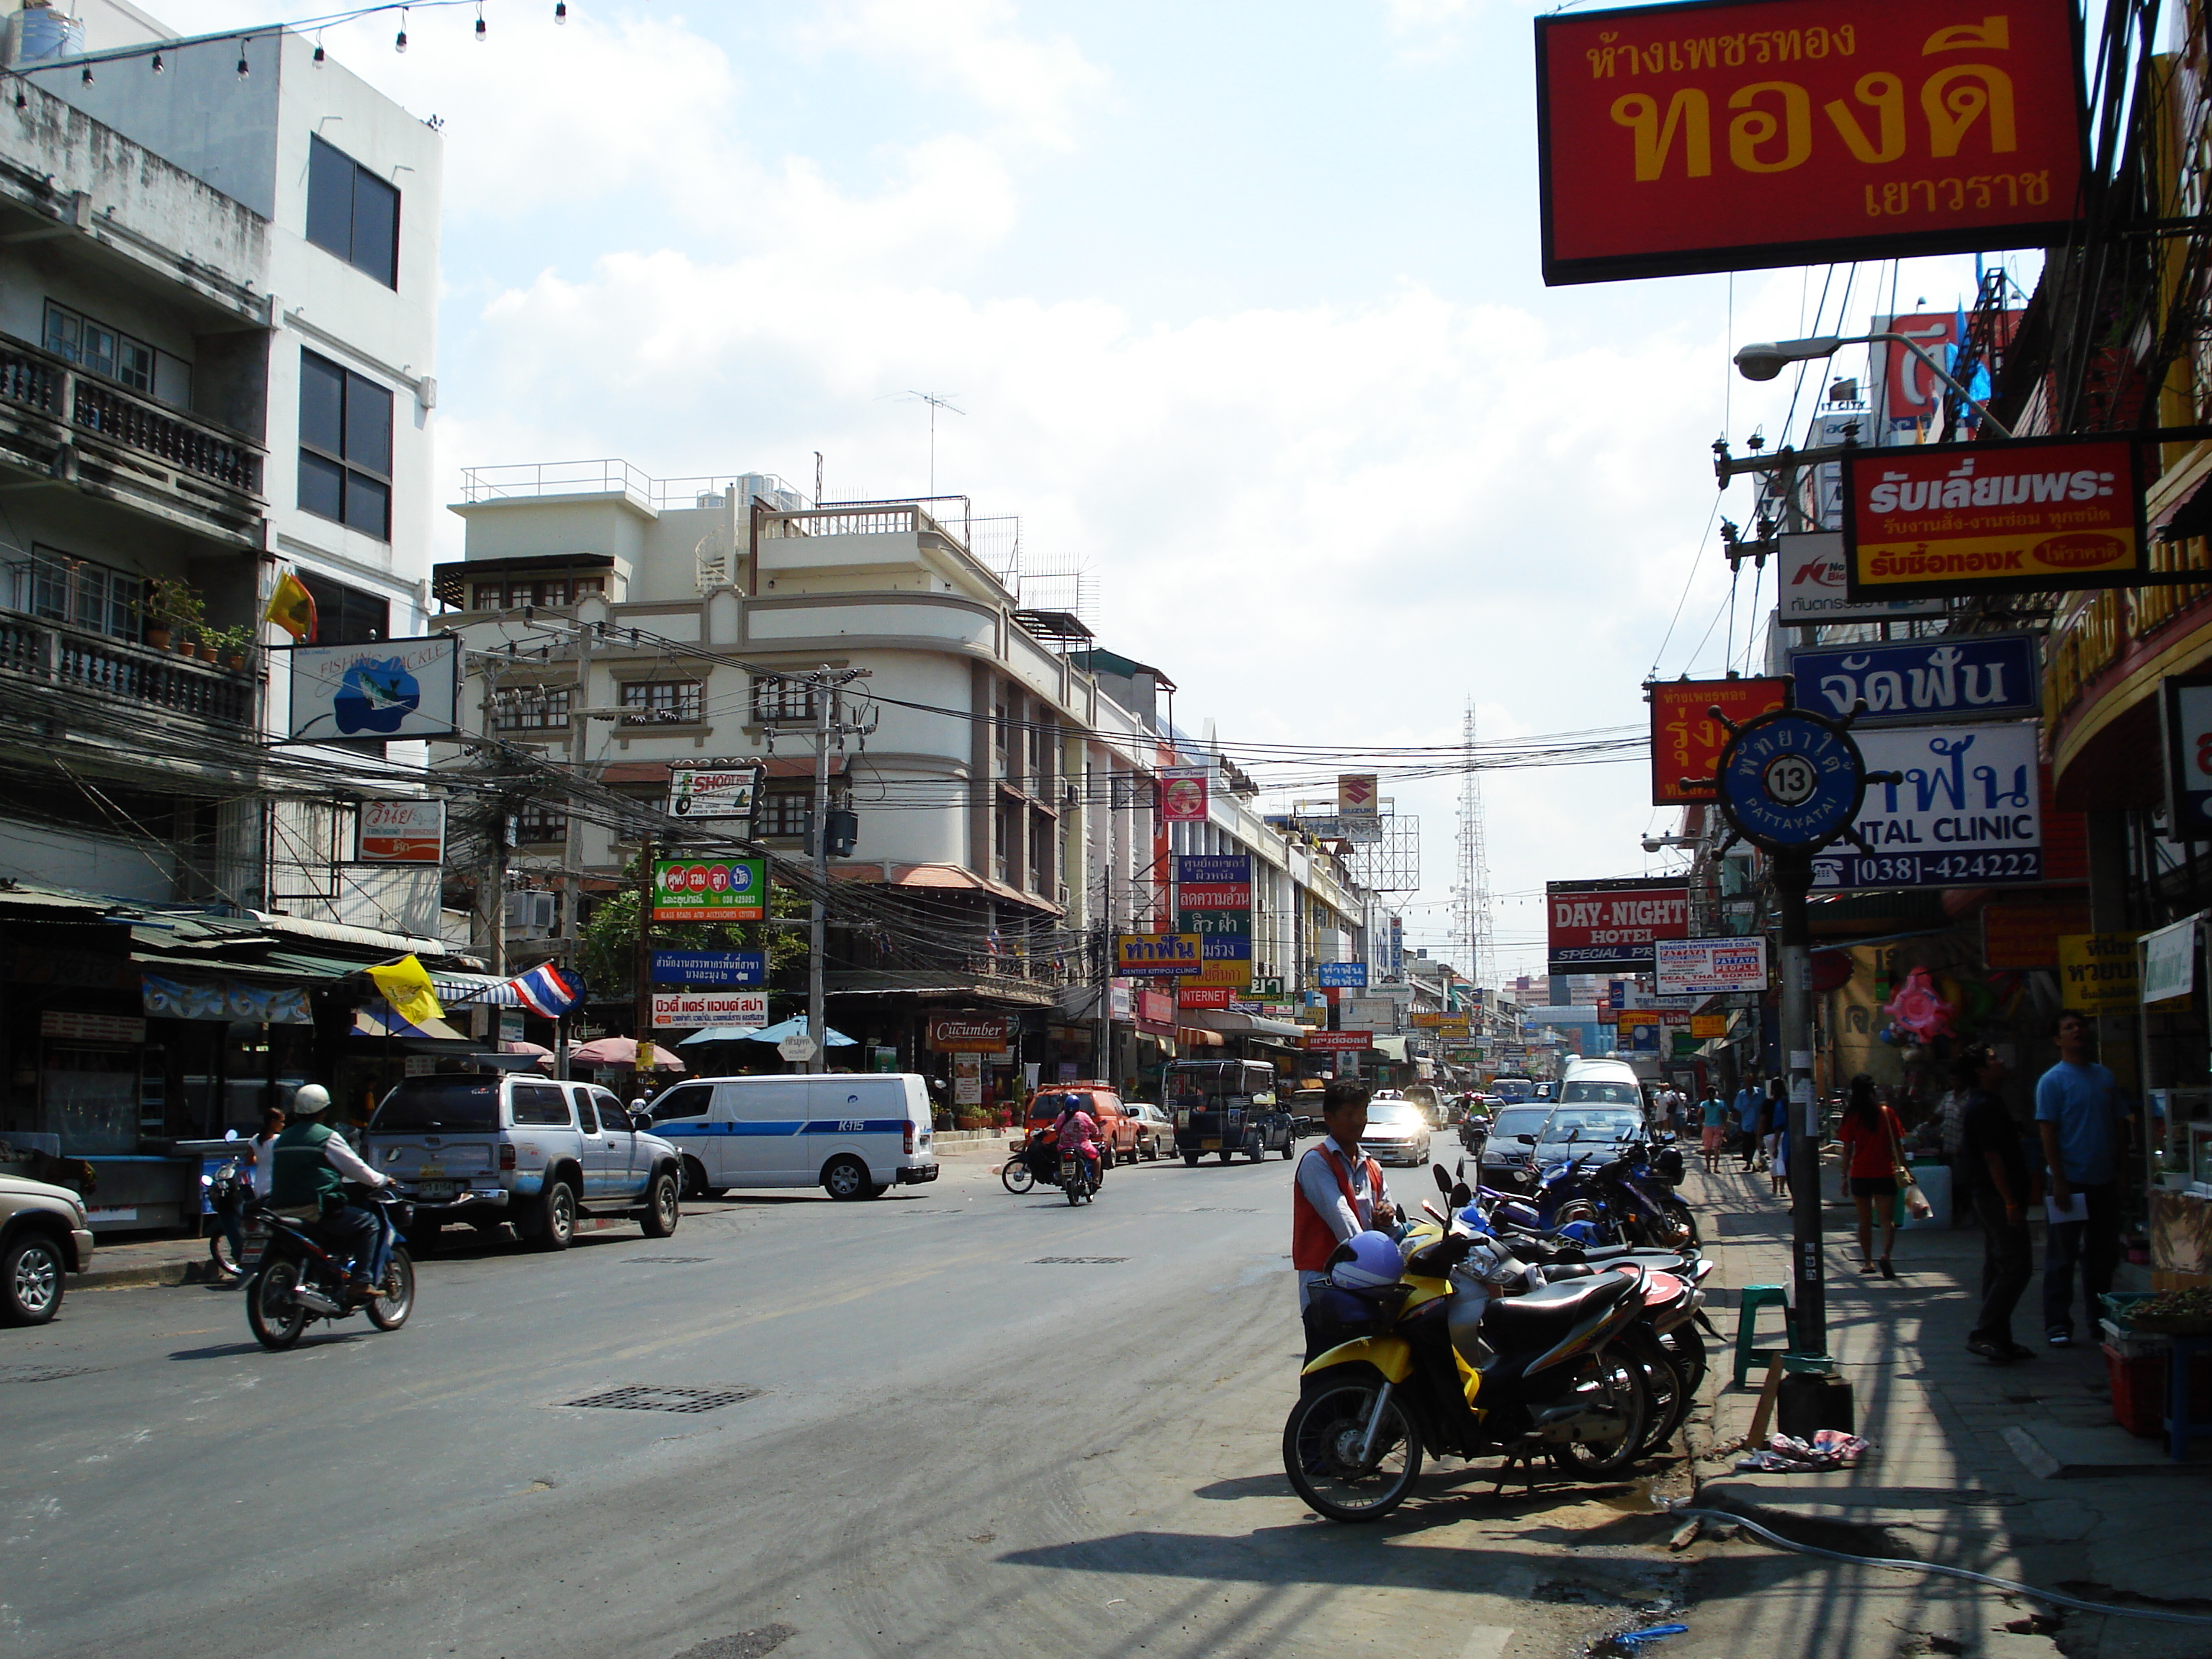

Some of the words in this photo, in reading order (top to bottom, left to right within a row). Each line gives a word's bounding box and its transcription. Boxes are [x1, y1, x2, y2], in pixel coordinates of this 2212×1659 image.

[1586, 24, 1856, 79] ห้างเพชรทอง
[1610, 15, 2017, 182] ทองดี
[1865, 168, 2051, 217] เยาวราช
[1869, 458, 2115, 513] รับเลี่ยมพระ
[2049, 505, 2111, 529] ทุกชนิด
[320, 650, 382, 677] FISHING
[390, 642, 445, 671] TACKLE
[1820, 647, 2008, 714] จัดฟัน
[1737, 729, 1855, 776] พัทยาใต้
[1774, 767, 1806, 793] 13
[1934, 814, 2033, 842] CLINIC
[1196, 869, 1234, 881] ผิวหนัง
[1179, 886, 1250, 907] ลดความอ้วน
[1125, 935, 1195, 960] ทำฟัน
[1392, 928, 1401, 976] SUZUKI
[1557, 948, 1622, 961] SPECIAL
[656, 953, 759, 969] สำนักงานสรรพากรพื้นที่สาขา
[1322, 964, 1364, 975] ทำฟัน
[1715, 956, 1756, 965] PATTAYA
[1715, 963, 1757, 972] PEOPLE
[685, 971, 719, 983] บางละมุง
[1250, 979, 1281, 994] ยา
[1322, 975, 1364, 986] จัดฟัน
[707, 998, 741, 1012] แอนด์
[741, 997, 764, 1011] สปา
[1181, 990, 1226, 1002] INTERNET
[937, 1022, 1002, 1040] Cucumber
